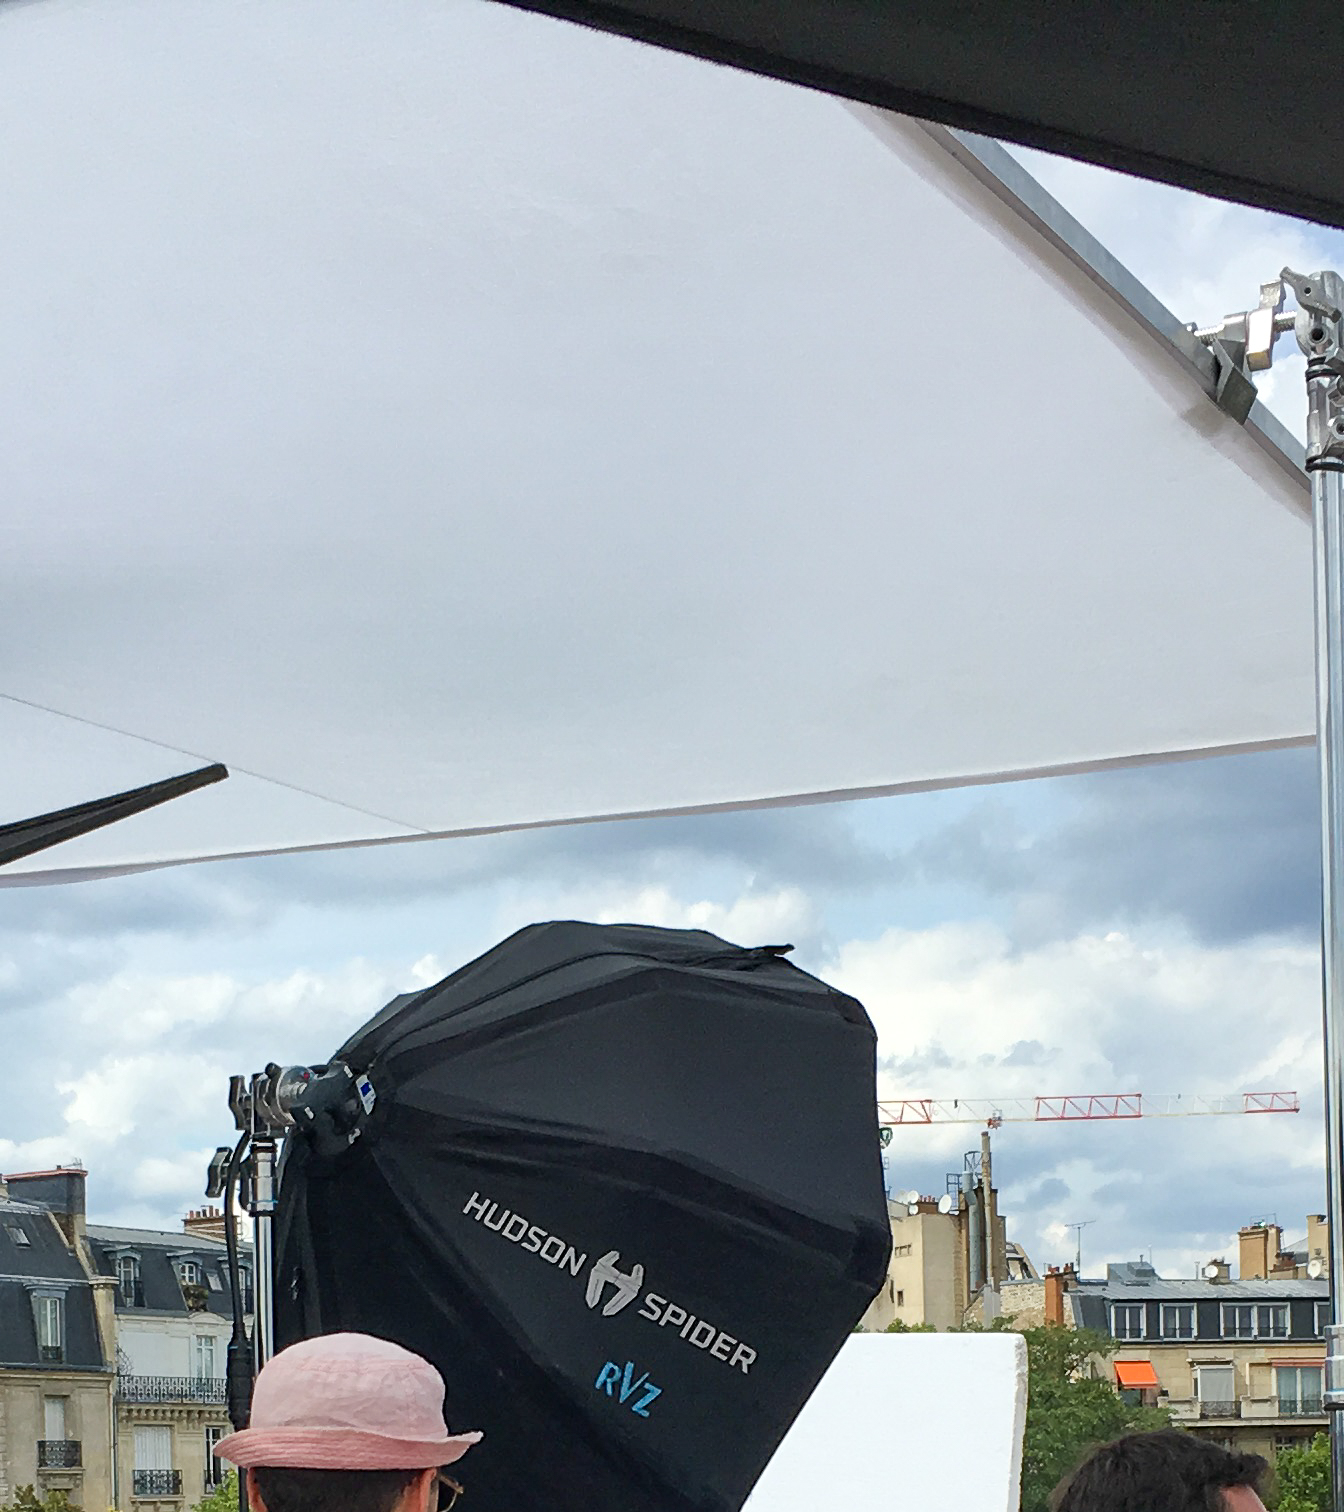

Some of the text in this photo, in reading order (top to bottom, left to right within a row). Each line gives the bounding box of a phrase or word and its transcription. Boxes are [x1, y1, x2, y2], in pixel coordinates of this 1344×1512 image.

[462, 1191, 758, 1374] HUDSON SPIDER
[595, 1360, 664, 1418] RVZ
